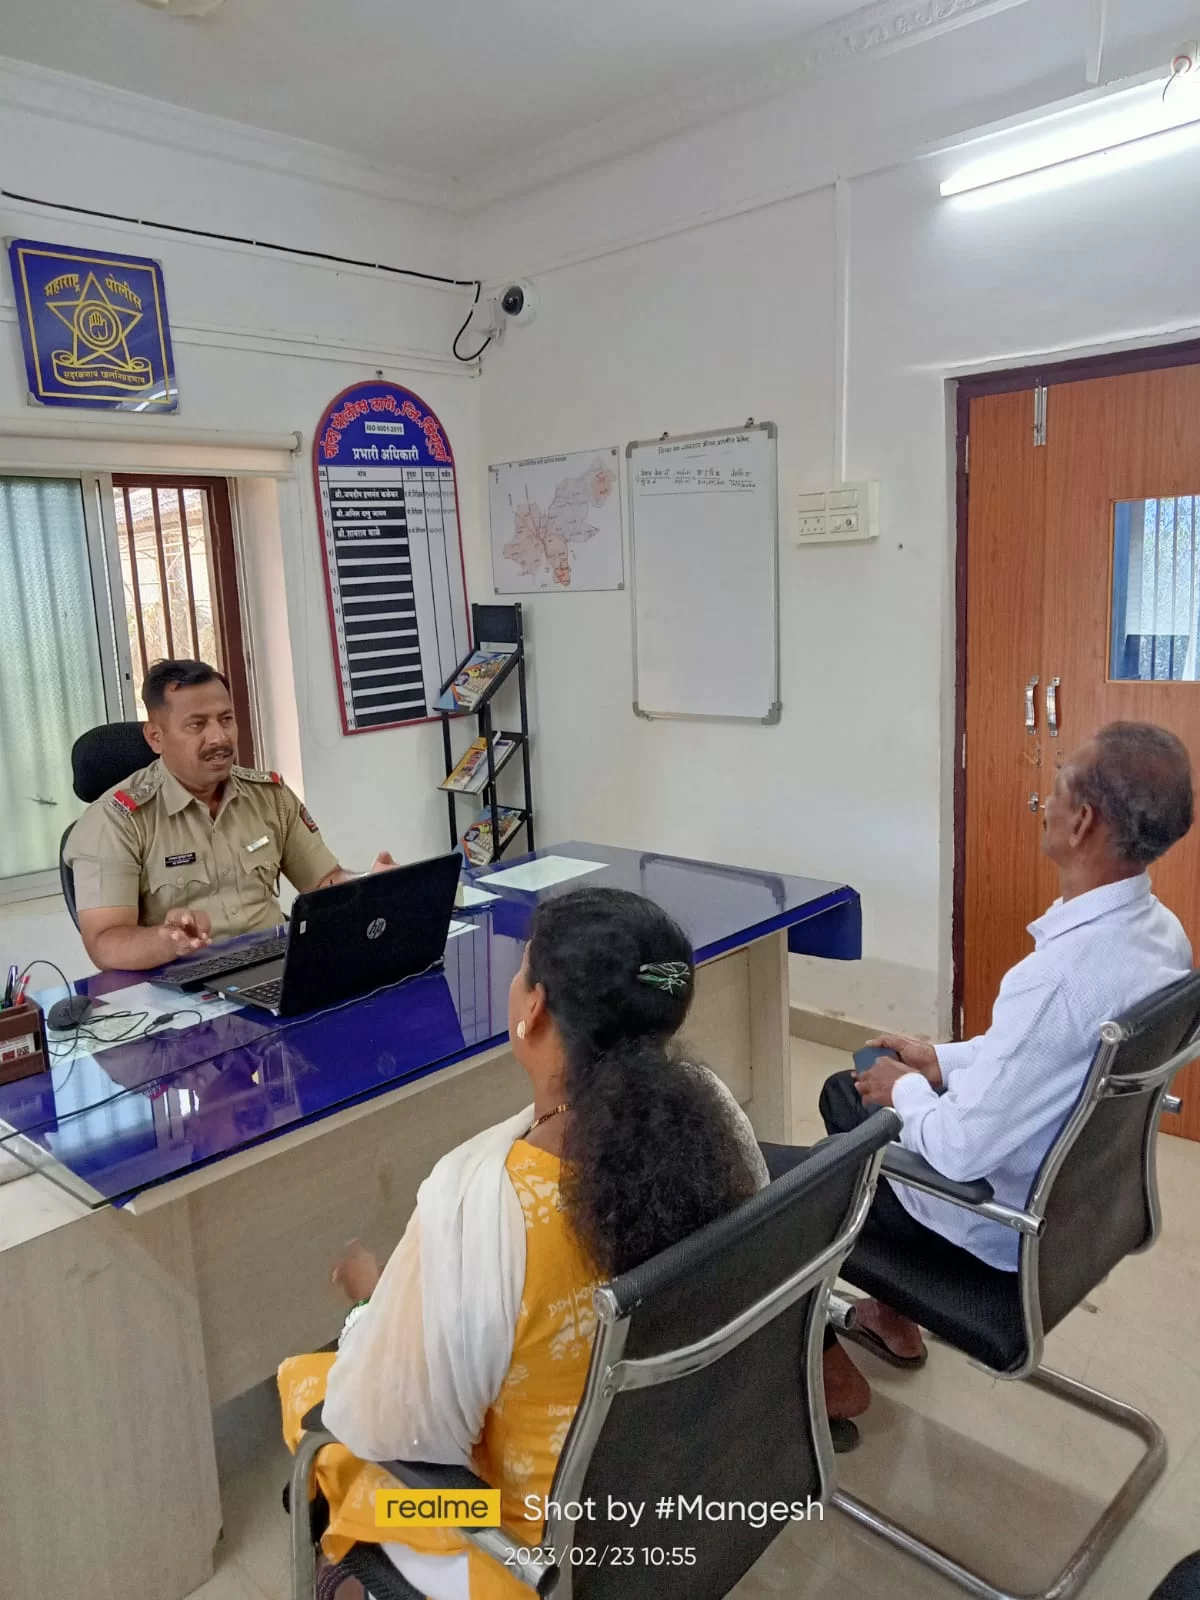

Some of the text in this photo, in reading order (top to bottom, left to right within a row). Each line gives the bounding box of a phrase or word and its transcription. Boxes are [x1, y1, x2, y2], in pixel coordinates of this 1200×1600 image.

[44, 273, 142, 311] महाराष्ट्र पोलीस
[352, 444, 419, 461] प्रभारी अधिकारी
[367, 918, 387, 939] hp
